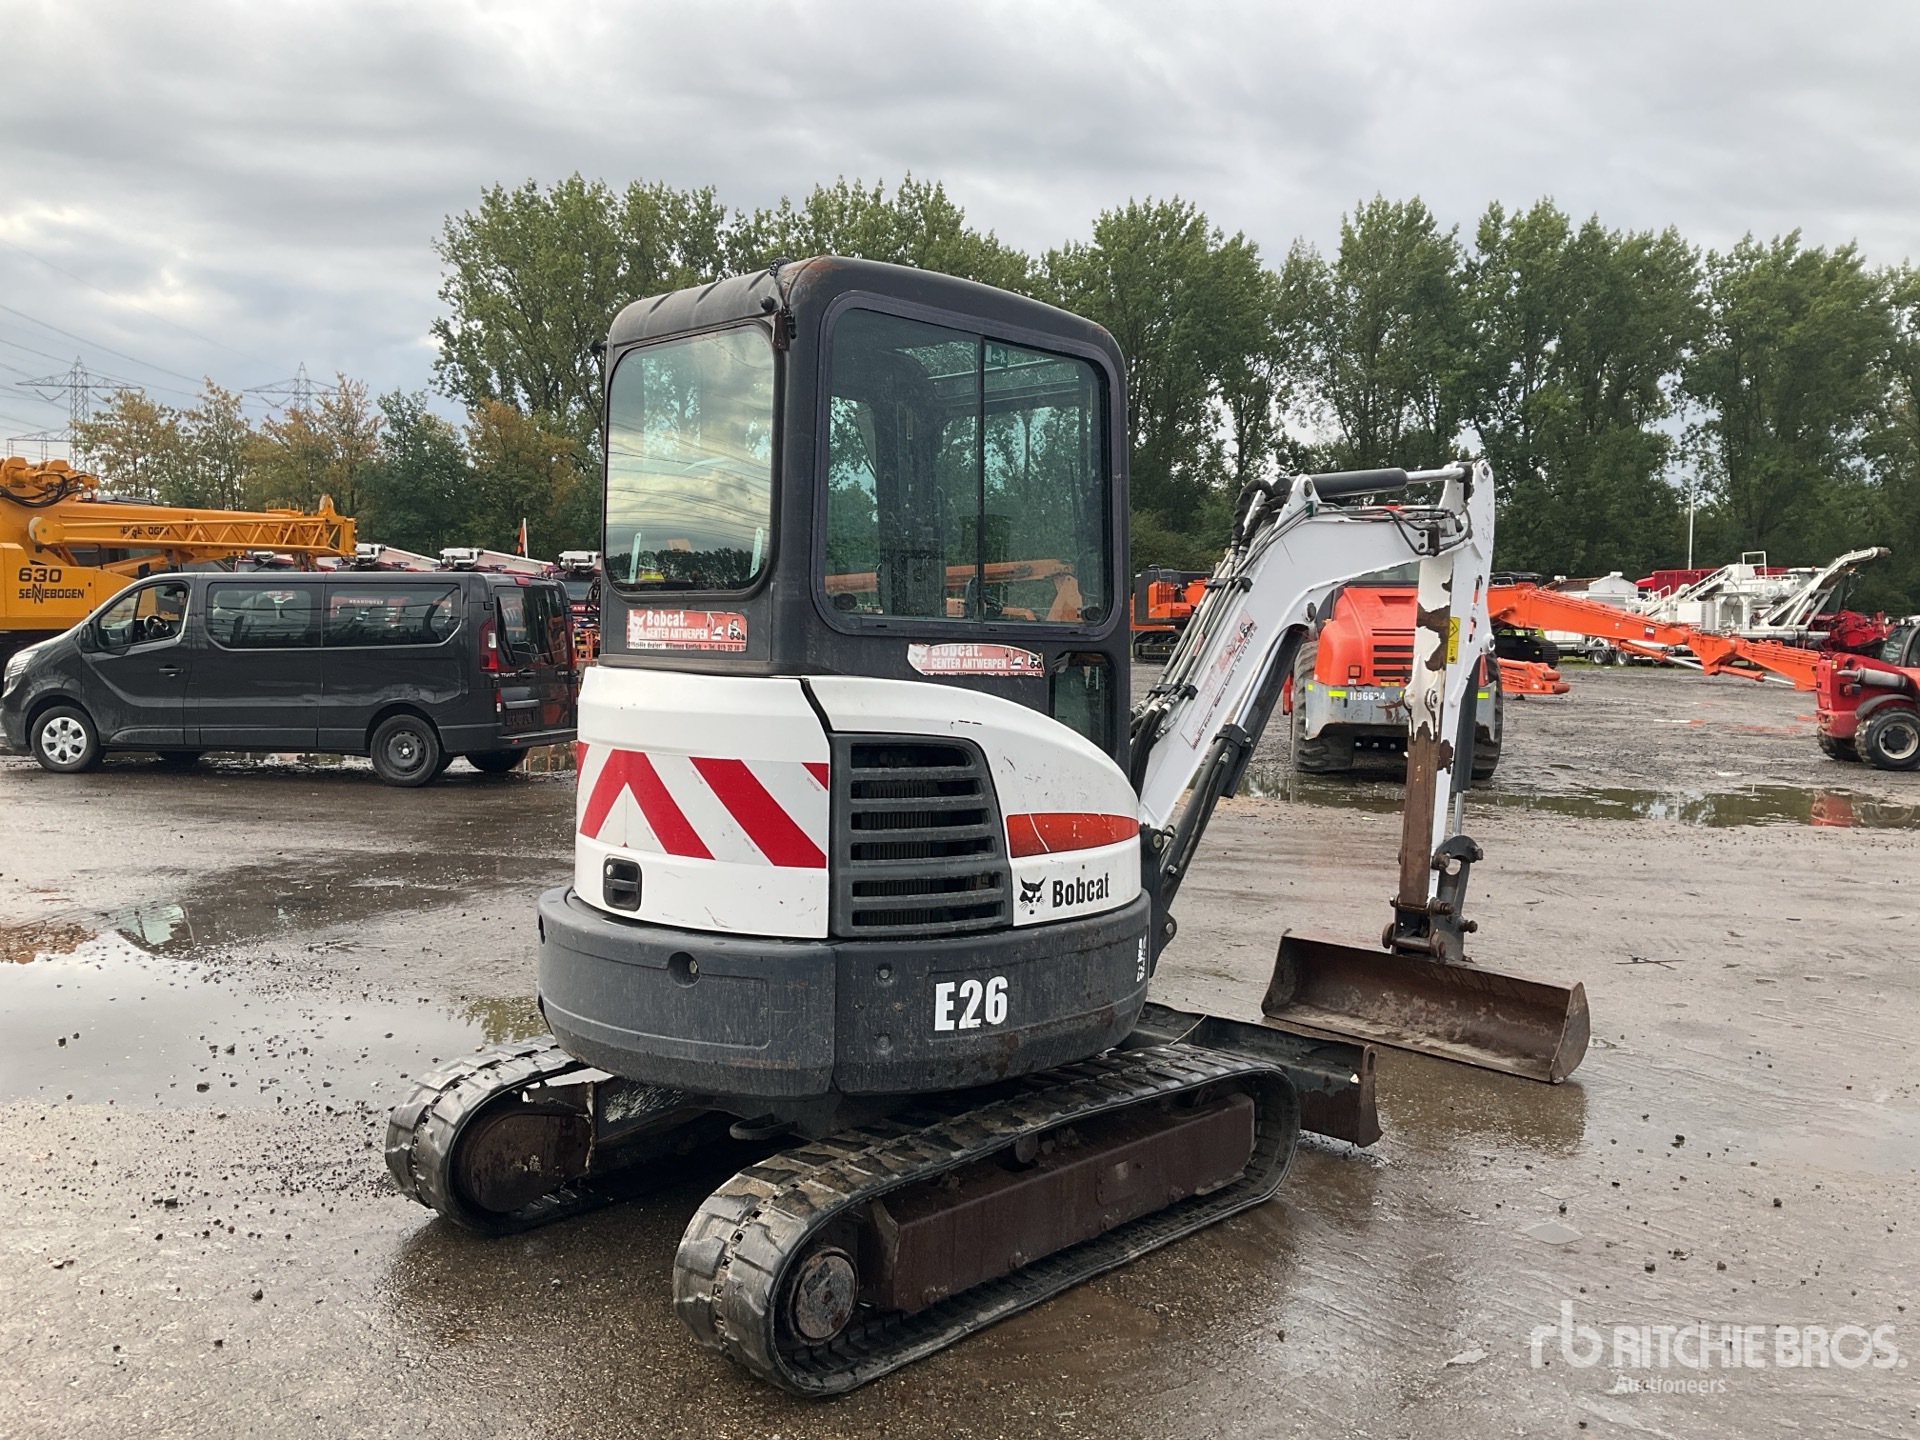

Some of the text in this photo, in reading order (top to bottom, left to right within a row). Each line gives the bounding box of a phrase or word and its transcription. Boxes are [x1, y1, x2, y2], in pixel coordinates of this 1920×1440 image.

[18, 567, 62, 582] 630
[18, 583, 84, 604] SENNEBOGEN
[670, 628, 708, 640] ANTWERPEN
[931, 658, 1007, 669] CENTER ANTWERPEN
[1052, 872, 1110, 908] Bobcat
[934, 976, 1009, 1031] E26
